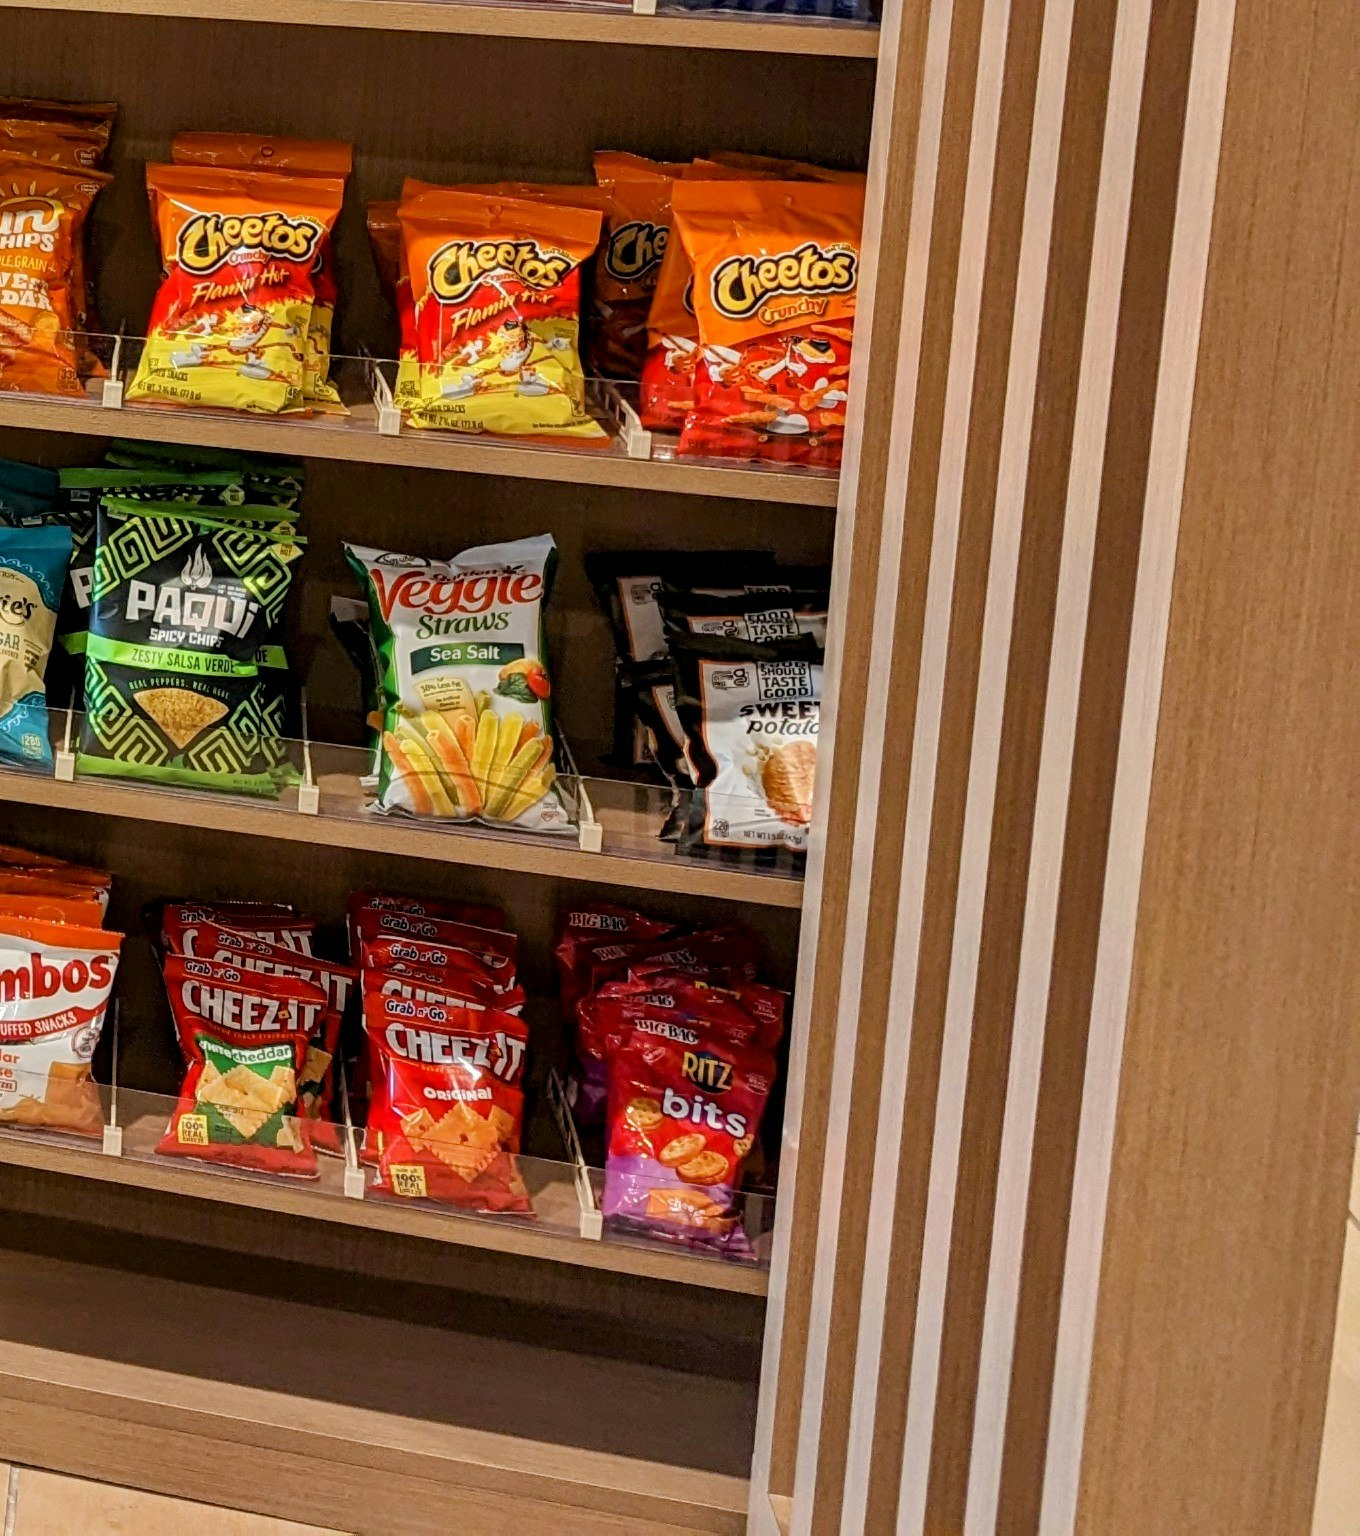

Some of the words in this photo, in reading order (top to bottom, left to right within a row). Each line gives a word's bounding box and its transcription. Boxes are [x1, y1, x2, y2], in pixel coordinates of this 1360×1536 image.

[180, 213, 317, 270] Cheetos
[14, 254, 48, 273] GRAIN
[430, 243, 572, 300] Cheetos
[714, 245, 855, 315] Cheetos
[758, 296, 827, 325] Crunchy
[370, 567, 543, 622] Veggie
[149, 627, 186, 643] SPICY
[415, 611, 510, 640] Straws
[132, 648, 164, 666] ZESTY
[166, 653, 201, 672] SALSA
[204, 658, 236, 674] VERDE
[430, 647, 462, 663] Sea
[465, 645, 501, 661] Salt
[760, 667, 807, 677] SHOULD
[761, 676, 808, 688] TASTE
[762, 687, 809, 699] GOOD
[390, 944, 418, 960] Grab
[34, 1011, 78, 1034] SNACKS
[232, 1045, 292, 1063] cheddar
[681, 1051, 734, 1092] RITZ
[662, 1087, 749, 1139] bits
